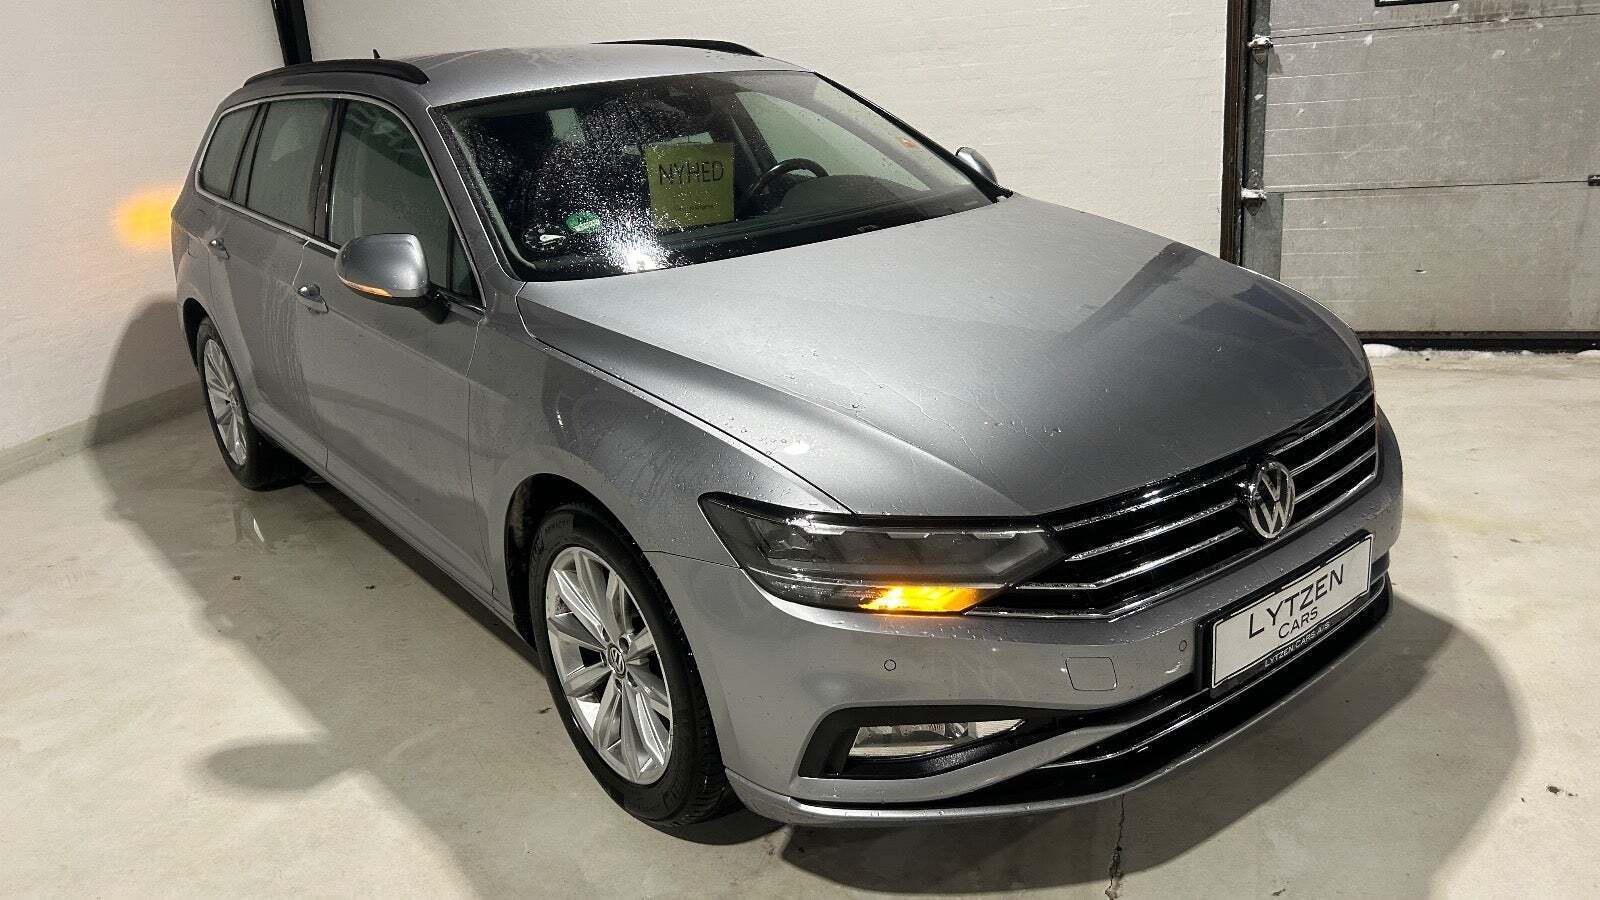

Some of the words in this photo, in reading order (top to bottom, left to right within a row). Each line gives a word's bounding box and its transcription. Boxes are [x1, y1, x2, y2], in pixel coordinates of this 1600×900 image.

[658, 160, 724, 185] NYHED
[1249, 563, 1344, 639] LYTZEN
[1278, 606, 1318, 639] CARS
[1264, 644, 1294, 667] LYTZEN
[1295, 630, 1316, 648] CARS
